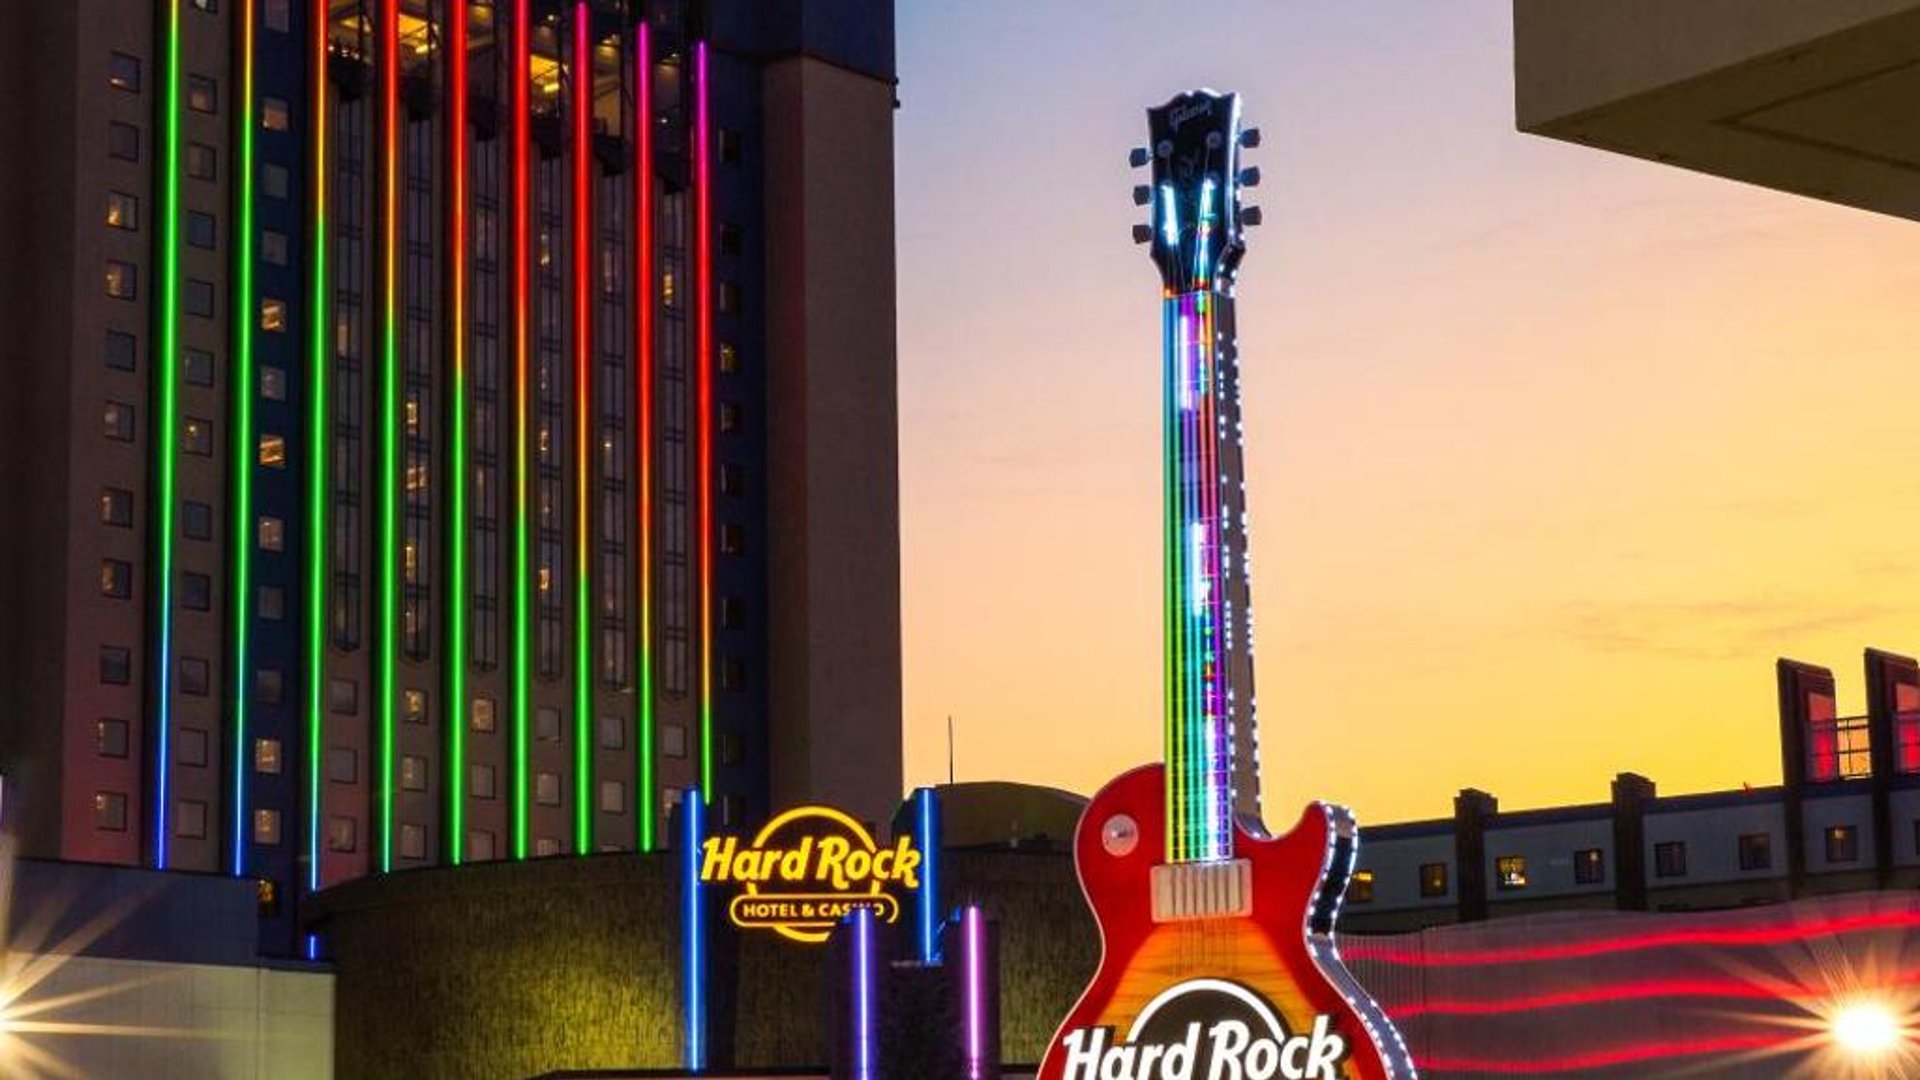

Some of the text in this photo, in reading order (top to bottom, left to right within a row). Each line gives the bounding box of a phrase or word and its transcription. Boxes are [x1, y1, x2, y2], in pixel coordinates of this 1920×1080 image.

[700, 836, 922, 890] Hard Rock
[742, 903, 798, 918] HOTEL
[801, 903, 815, 918] &
[1062, 1014, 1344, 1080] Hard Rock
